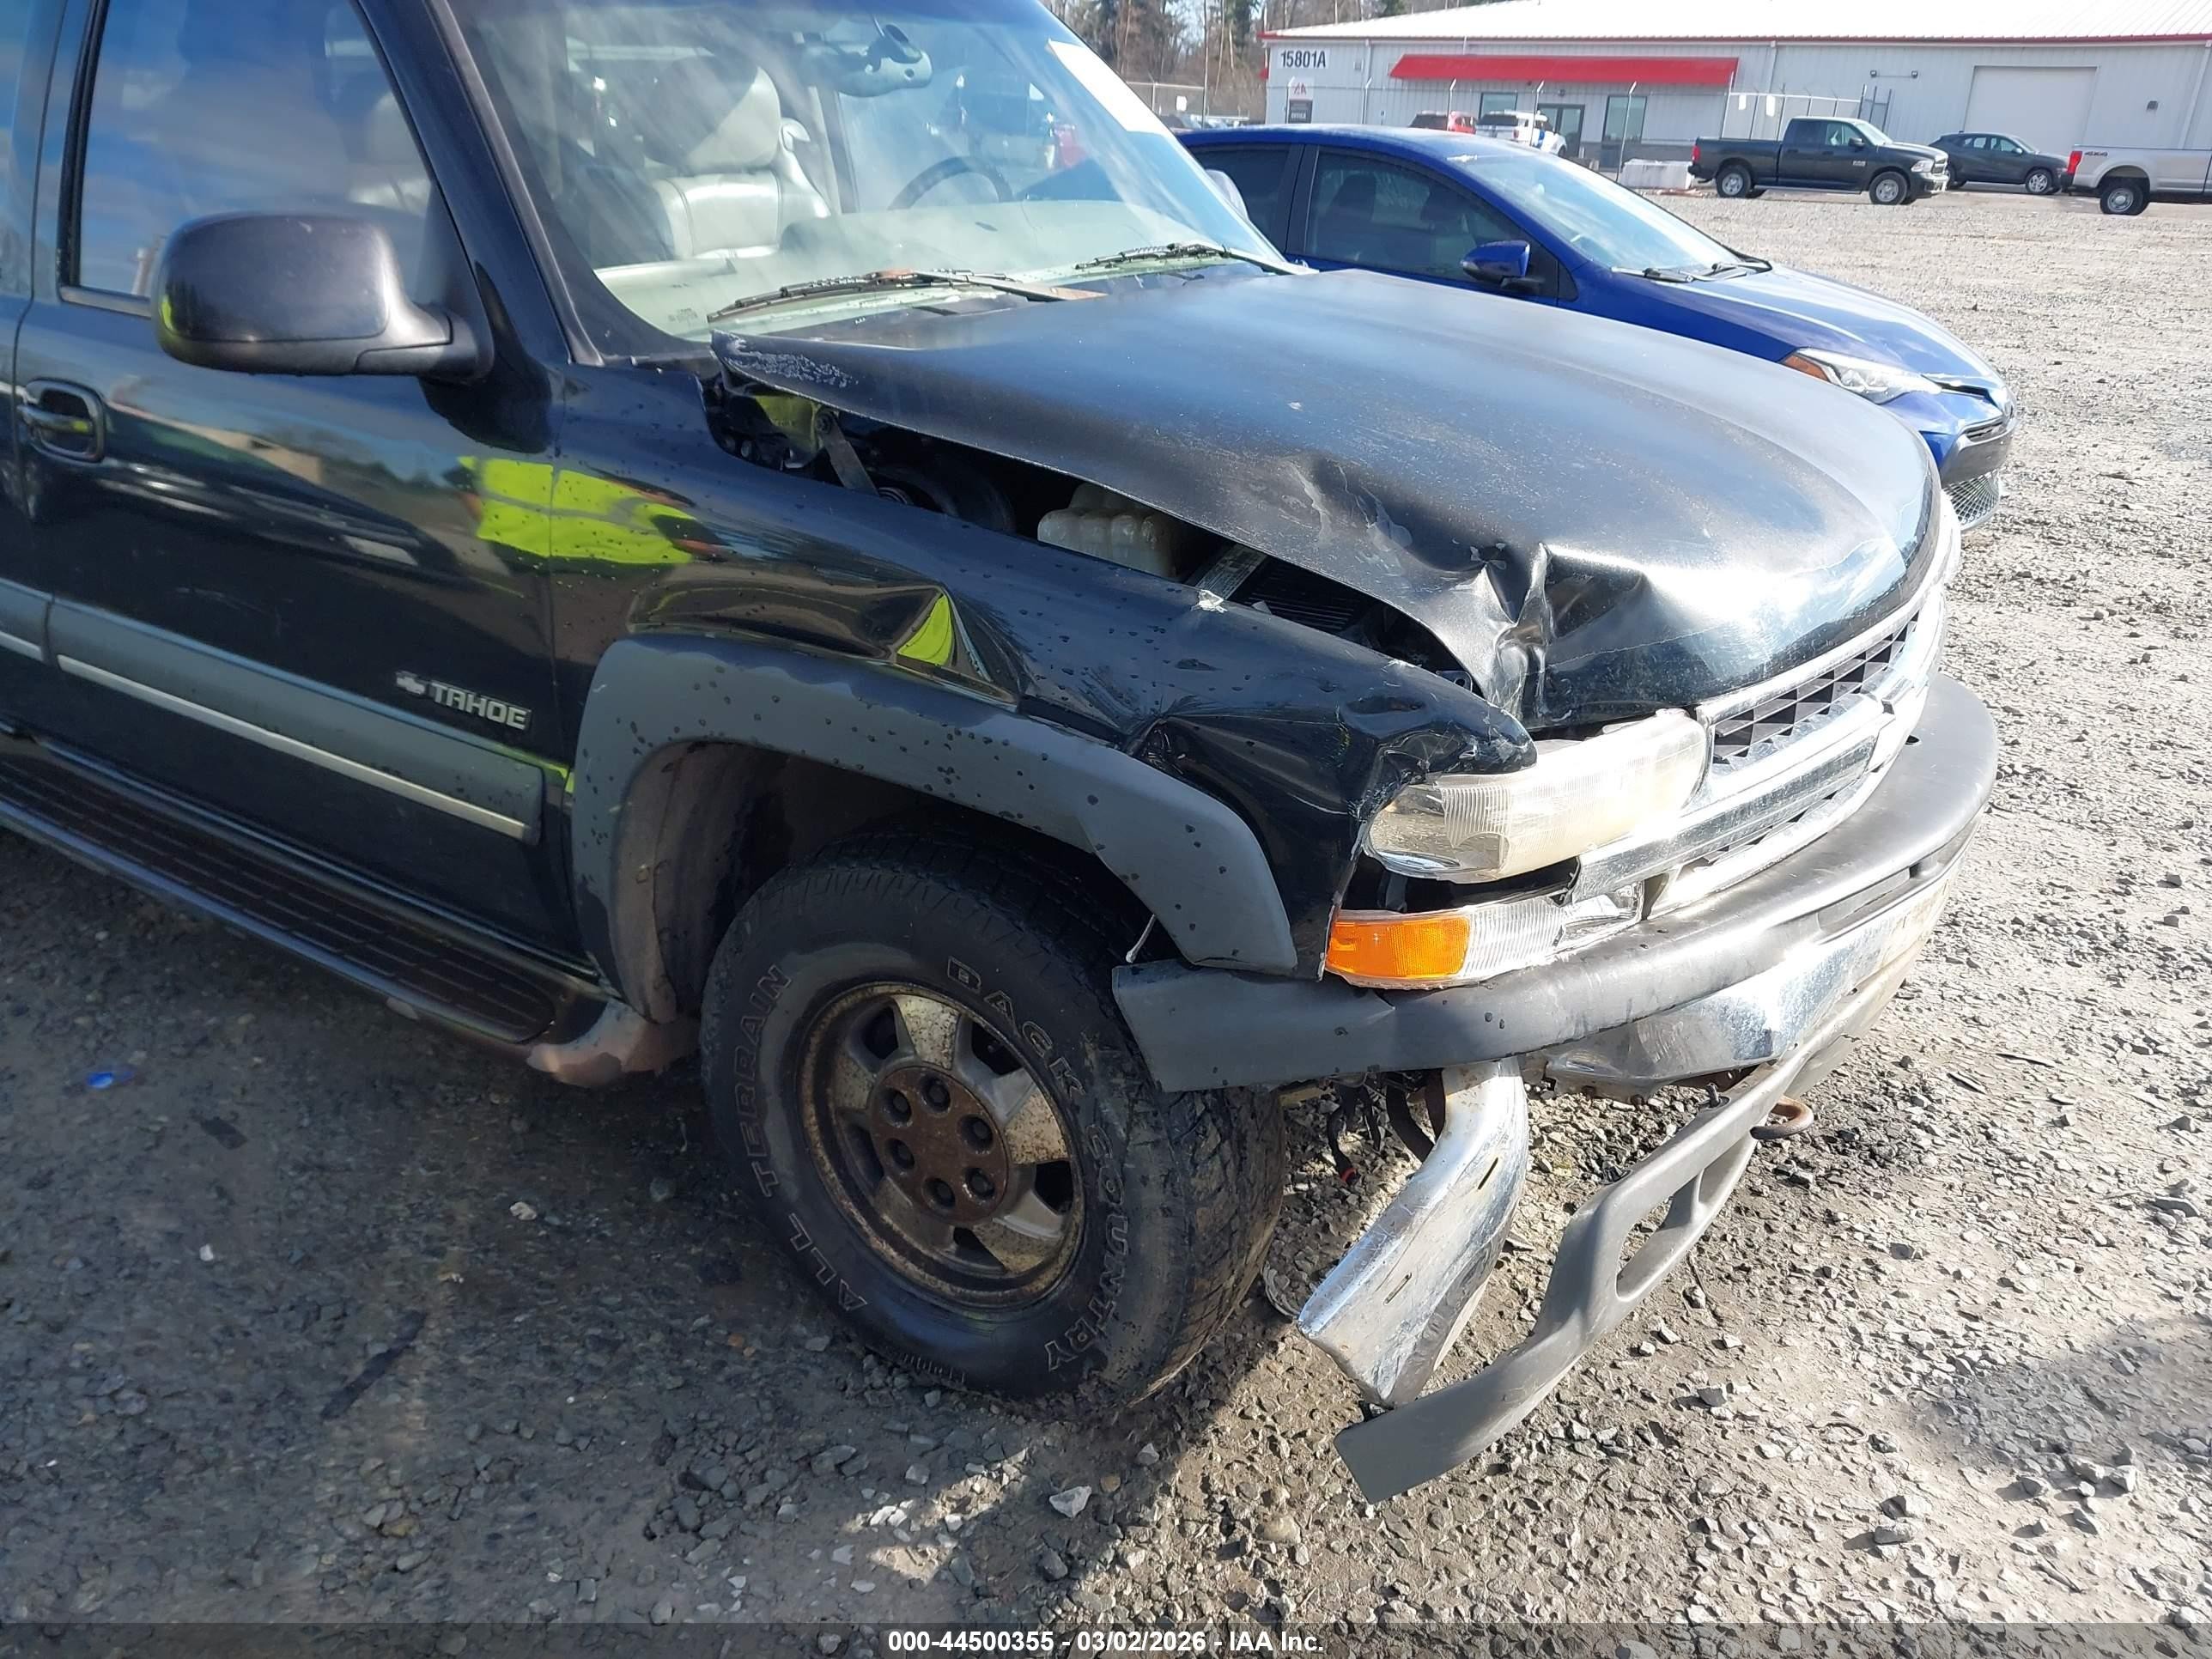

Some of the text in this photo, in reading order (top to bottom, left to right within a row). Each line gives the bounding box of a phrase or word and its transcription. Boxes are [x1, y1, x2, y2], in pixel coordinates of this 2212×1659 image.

[1280, 50, 1326, 68] 15801A
[430, 679, 531, 731] TAHOE
[734, 964, 868, 1311] ALL TERRAIN
[947, 955, 1129, 1373] BACK COUNTRY
